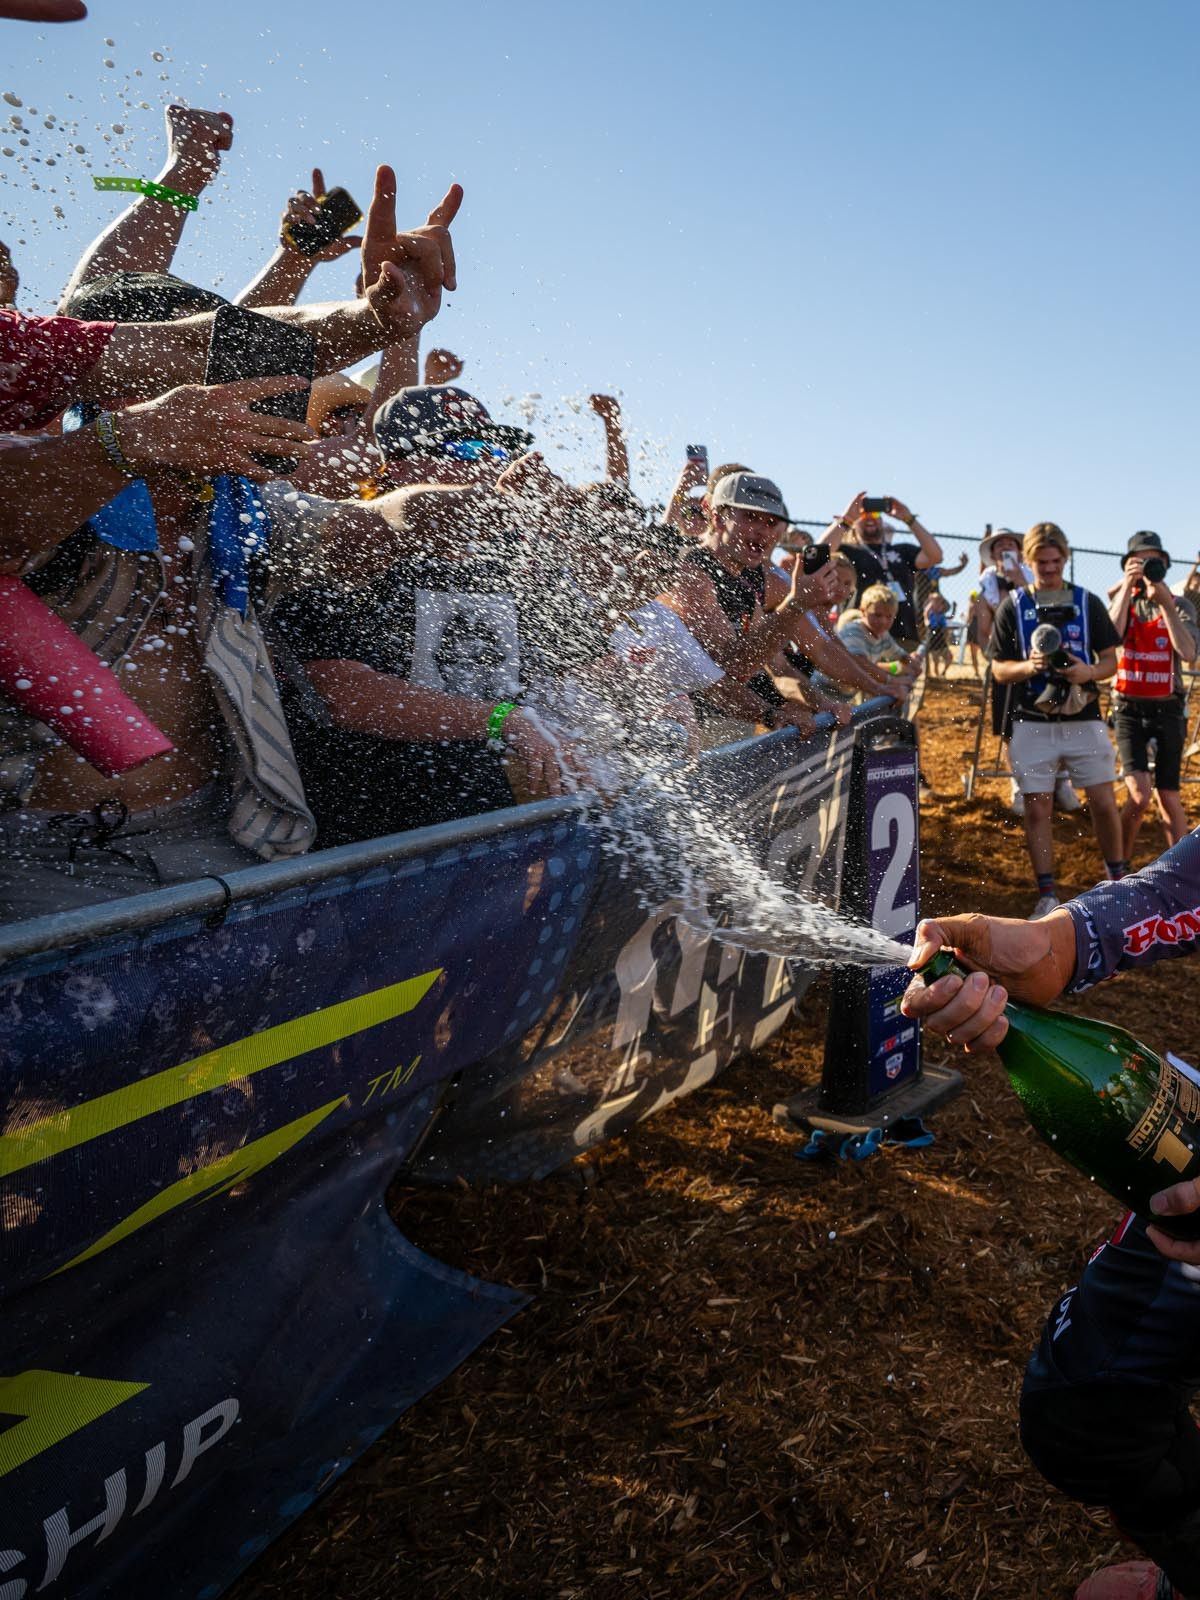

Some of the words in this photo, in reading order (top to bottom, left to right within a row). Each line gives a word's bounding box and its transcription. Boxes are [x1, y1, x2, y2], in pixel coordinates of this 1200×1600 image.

[1145, 671, 1169, 683] ROW
[871, 792, 917, 940] 2
[361, 1054, 422, 1106] TM
